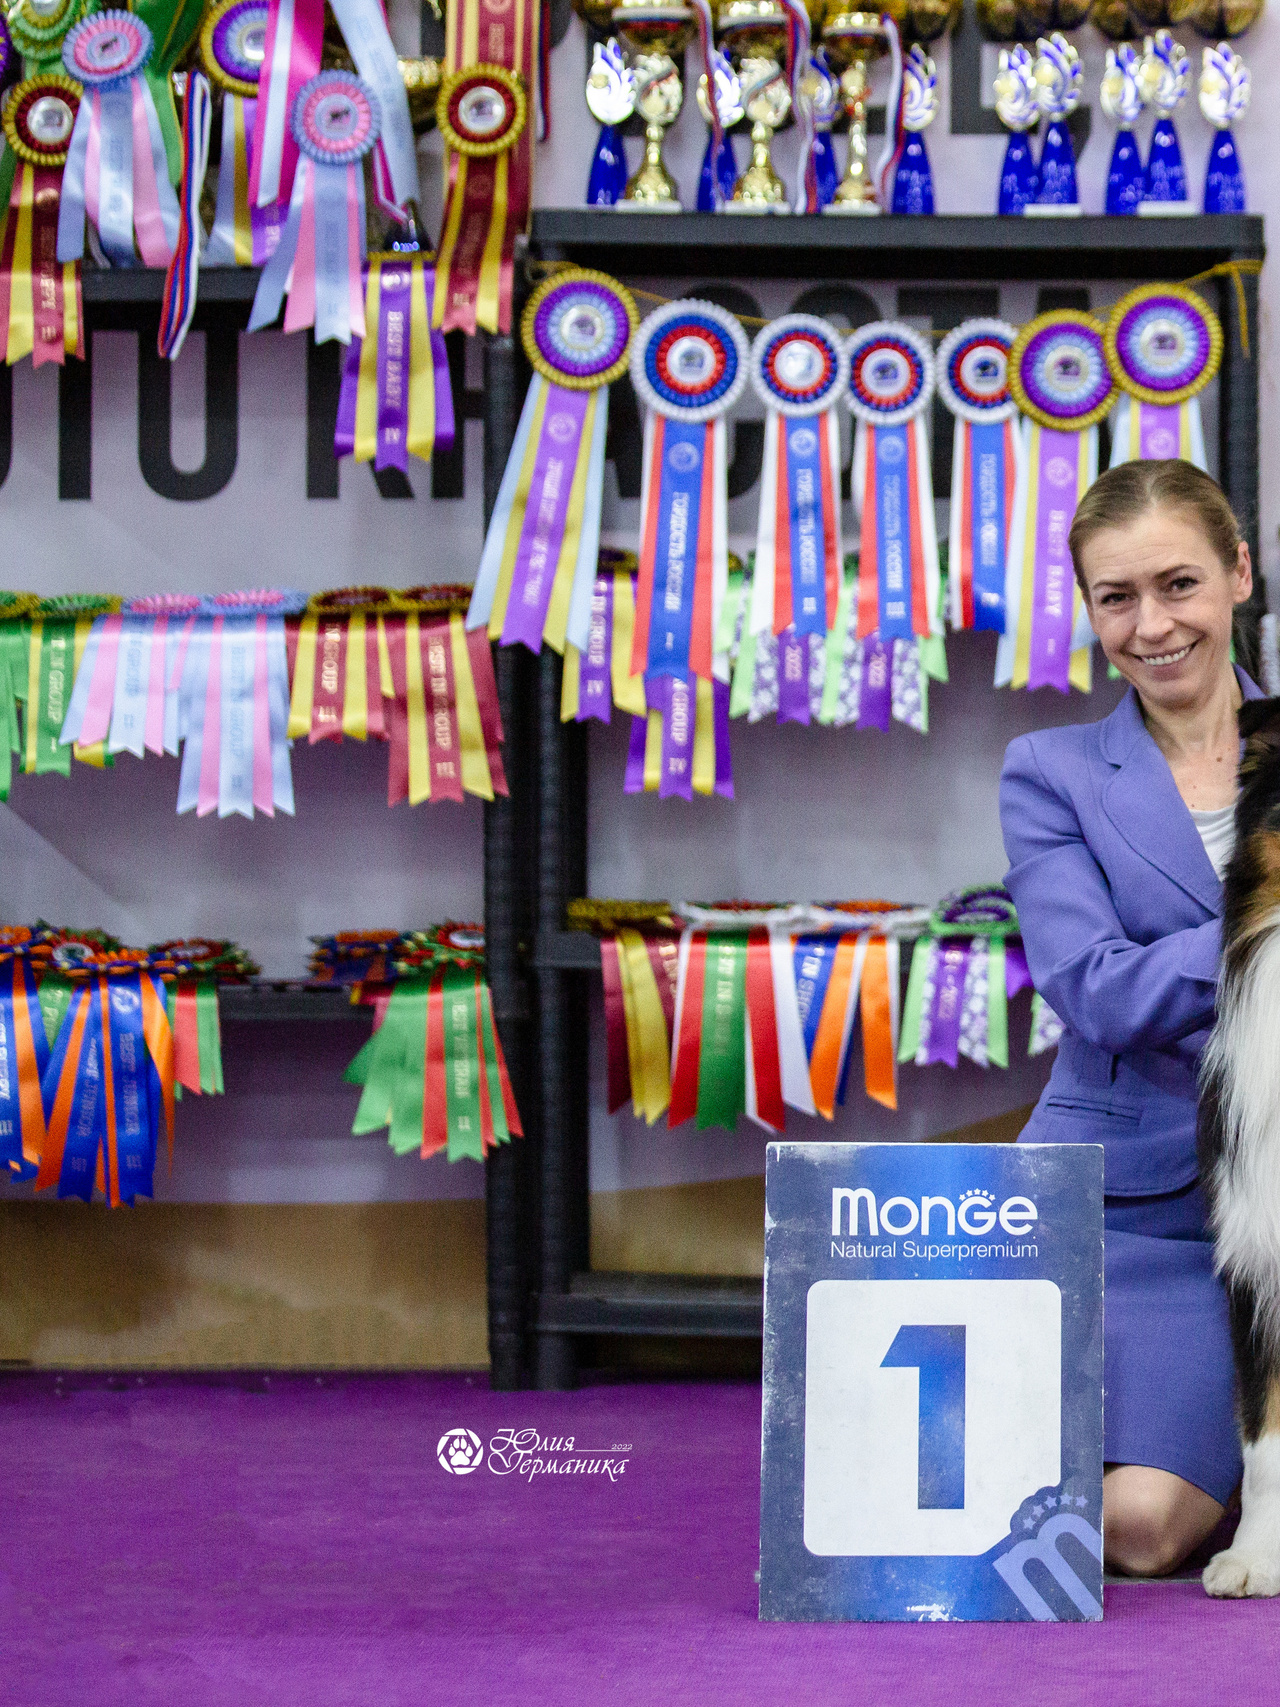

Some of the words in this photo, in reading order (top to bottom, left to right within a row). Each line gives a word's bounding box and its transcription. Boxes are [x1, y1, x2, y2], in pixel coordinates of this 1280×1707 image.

[386, 311, 404, 357] BEST
[385, 360, 403, 409] BABY
[668, 491, 690, 559] ГОРДОСТЬ
[1048, 509, 1067, 558] BEST
[664, 559, 686, 613] РОССИИ
[1045, 564, 1064, 618] BABY
[321, 641, 339, 694] GROUP
[588, 614, 606, 668] GROUP
[784, 646, 803, 682] 2022
[47, 670, 65, 724] GROUP
[868, 653, 887, 688] 2022
[433, 695, 452, 750] GROUP
[671, 691, 690, 746] GROUP
[801, 955, 821, 980] IN
[830, 1240, 897, 1258] Natural
[902, 1240, 1039, 1262] Superpremium
[879, 1324, 967, 1510] 1
